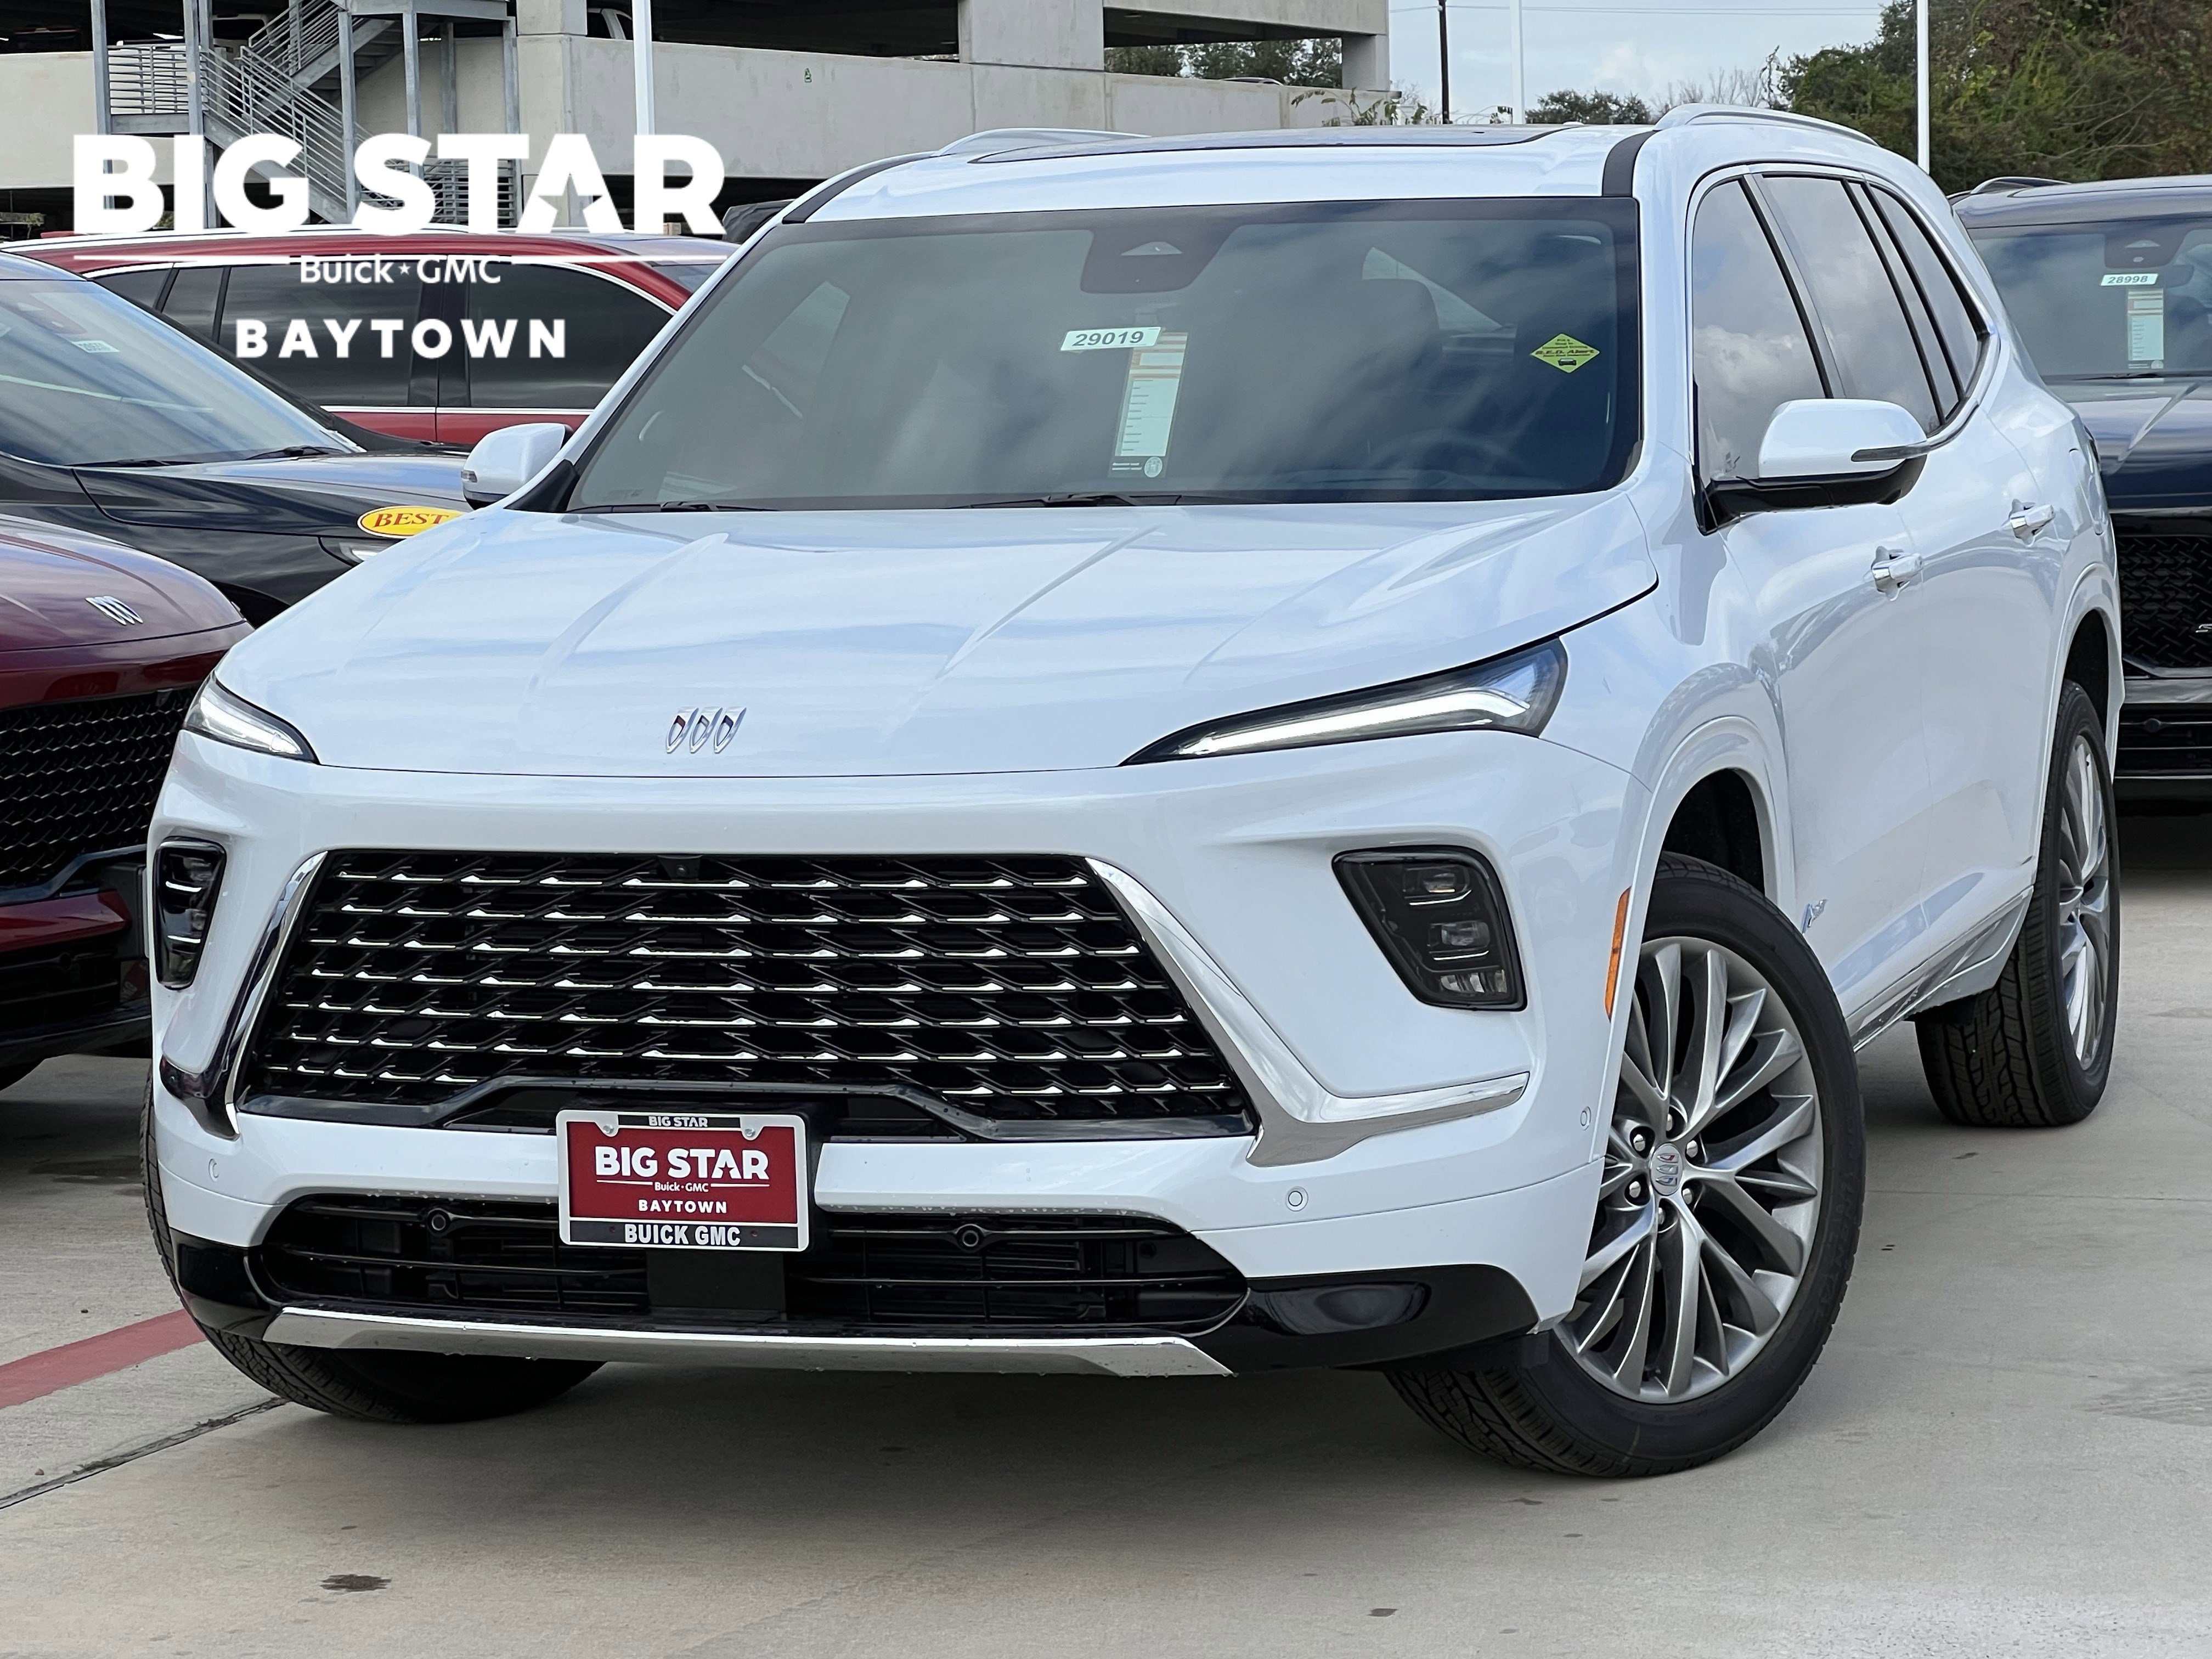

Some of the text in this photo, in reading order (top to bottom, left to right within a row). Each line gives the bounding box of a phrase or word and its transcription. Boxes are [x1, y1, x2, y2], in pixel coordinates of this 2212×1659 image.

[1073, 331, 1144, 346] 29019
[374, 513, 449, 527] BEST
[649, 1116, 708, 1127] BIG STAR
[596, 1147, 769, 1180] BIG STAR
[655, 1182, 709, 1192] Buick GMC
[639, 1200, 727, 1214] BAYTOWN
[625, 1224, 741, 1245] BUICK GMC
